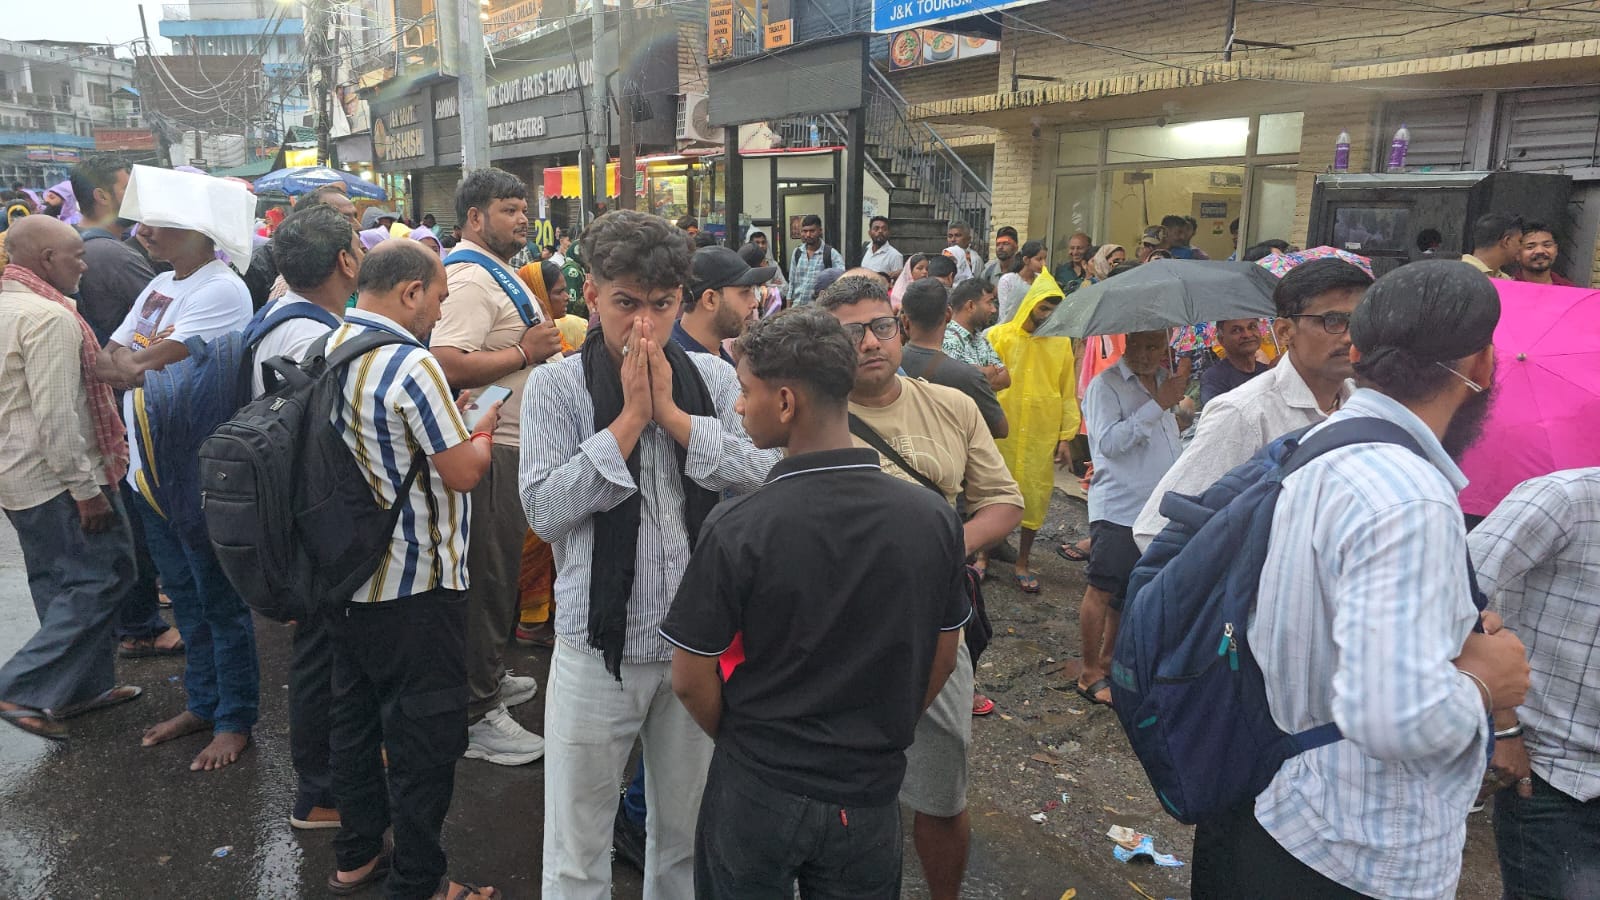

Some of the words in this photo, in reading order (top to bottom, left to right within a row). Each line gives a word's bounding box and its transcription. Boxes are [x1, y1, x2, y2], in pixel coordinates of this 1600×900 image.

[890, 5, 914, 21] J&K
[521, 72, 545, 100] ARTS
[516, 116, 545, 138] KATRA
[535, 219, 554, 252] 20
